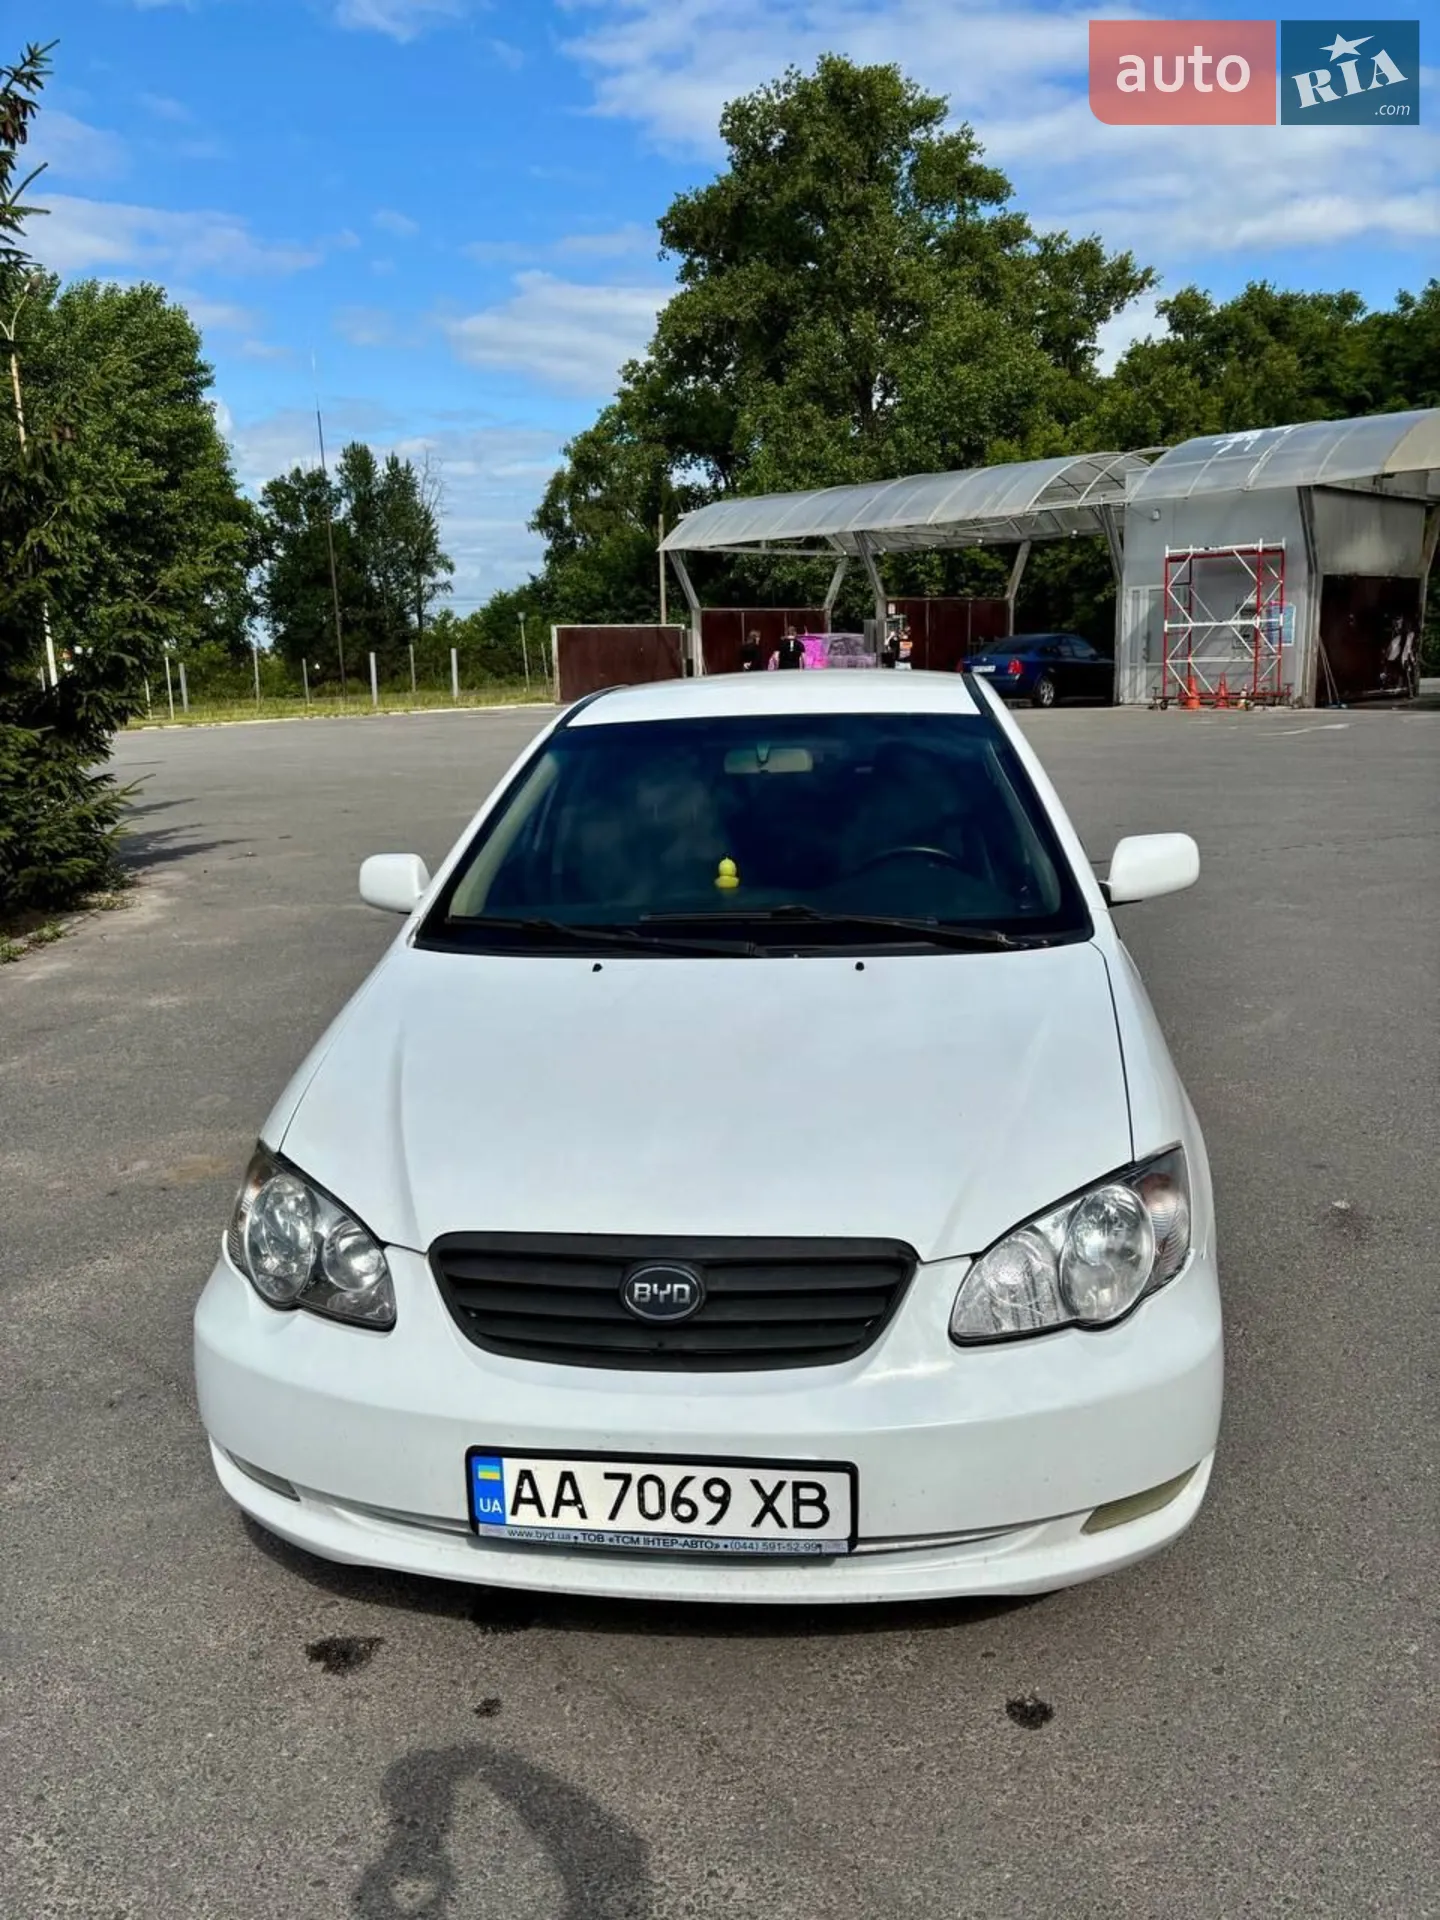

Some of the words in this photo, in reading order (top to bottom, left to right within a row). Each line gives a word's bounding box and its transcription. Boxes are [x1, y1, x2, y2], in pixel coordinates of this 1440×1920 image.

[633, 1282, 691, 1303] BYD
[479, 1497, 504, 1514] UA
[510, 1468, 588, 1520] AA
[603, 1471, 732, 1526] 7069
[749, 1478, 831, 1530] XB
[508, 1529, 571, 1541] www.byd.ua
